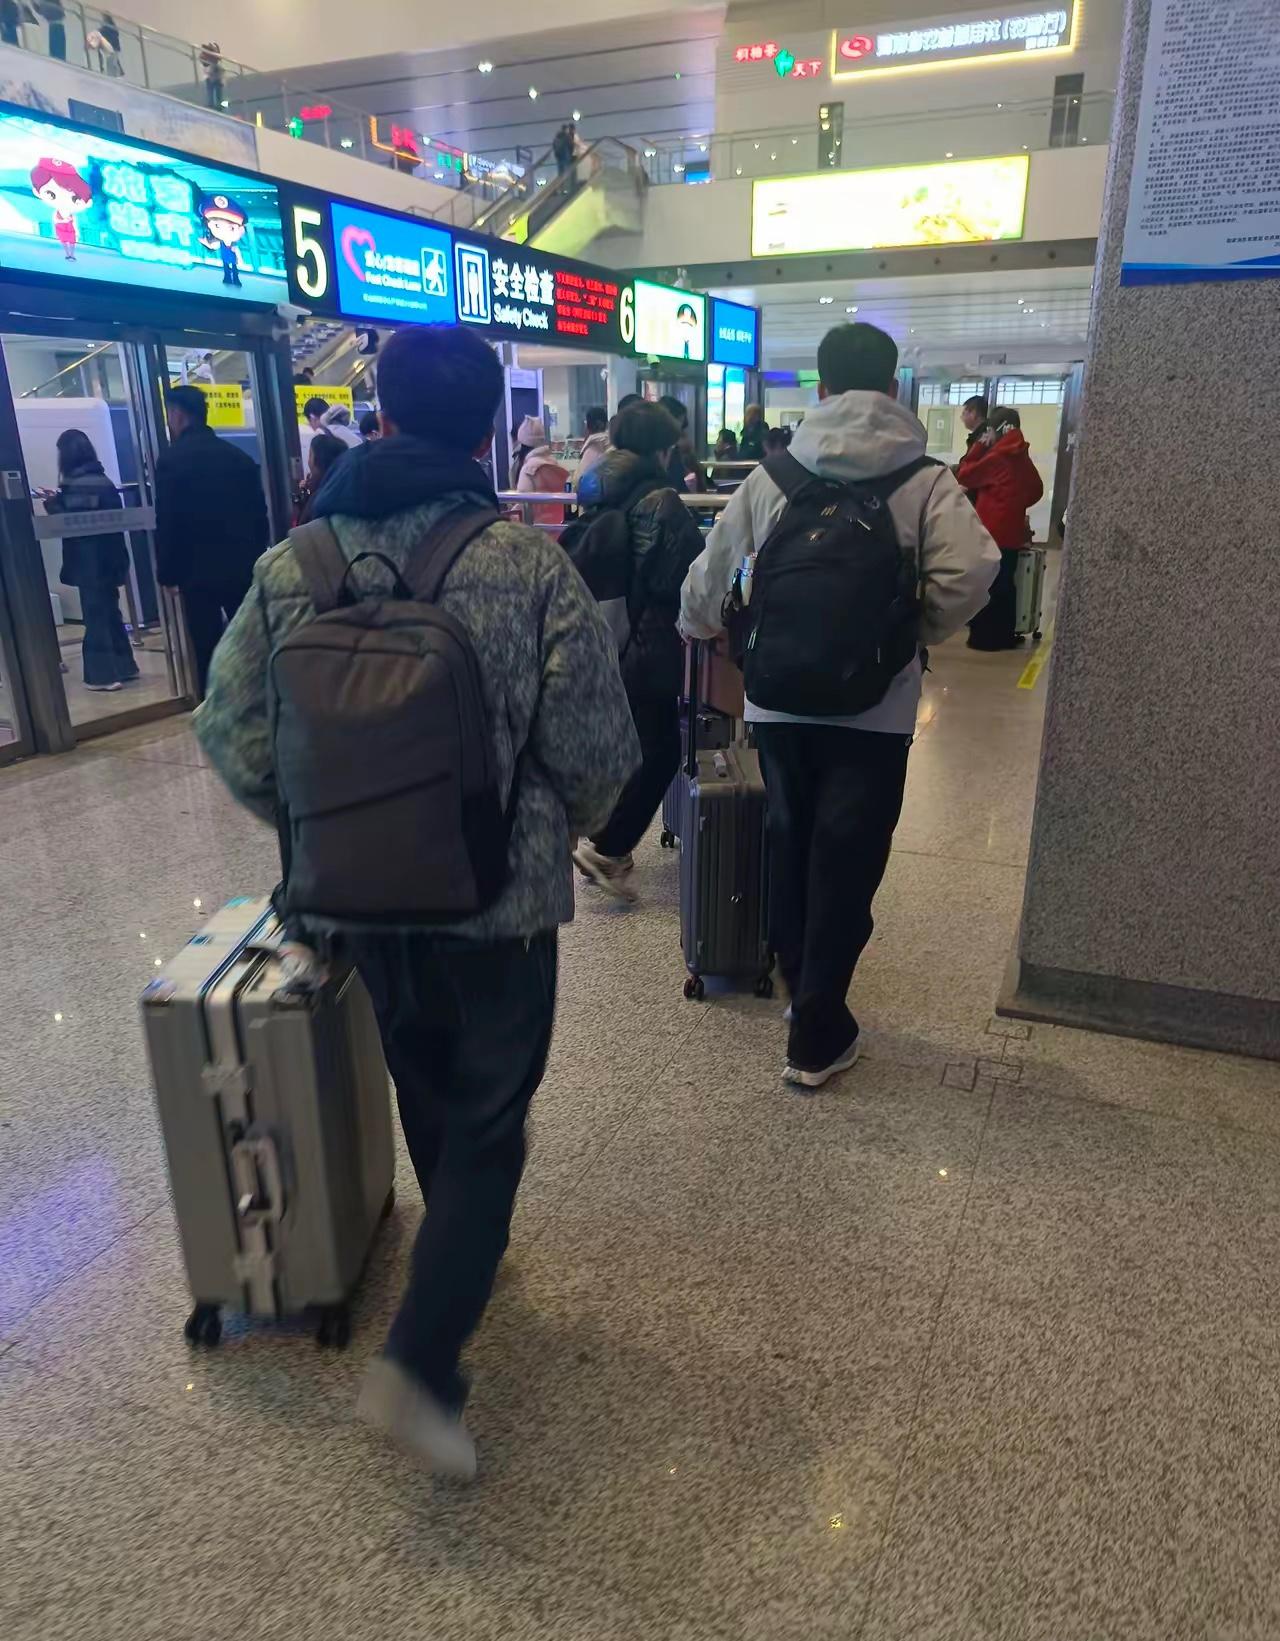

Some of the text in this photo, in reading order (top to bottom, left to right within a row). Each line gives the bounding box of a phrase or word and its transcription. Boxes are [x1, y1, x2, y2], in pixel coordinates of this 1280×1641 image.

[293, 206, 328, 298] 5
[492, 257, 554, 306] 安全检查
[493, 302, 522, 330] Safety
[522, 307, 549, 330] Check
[619, 286, 635, 344] 6
